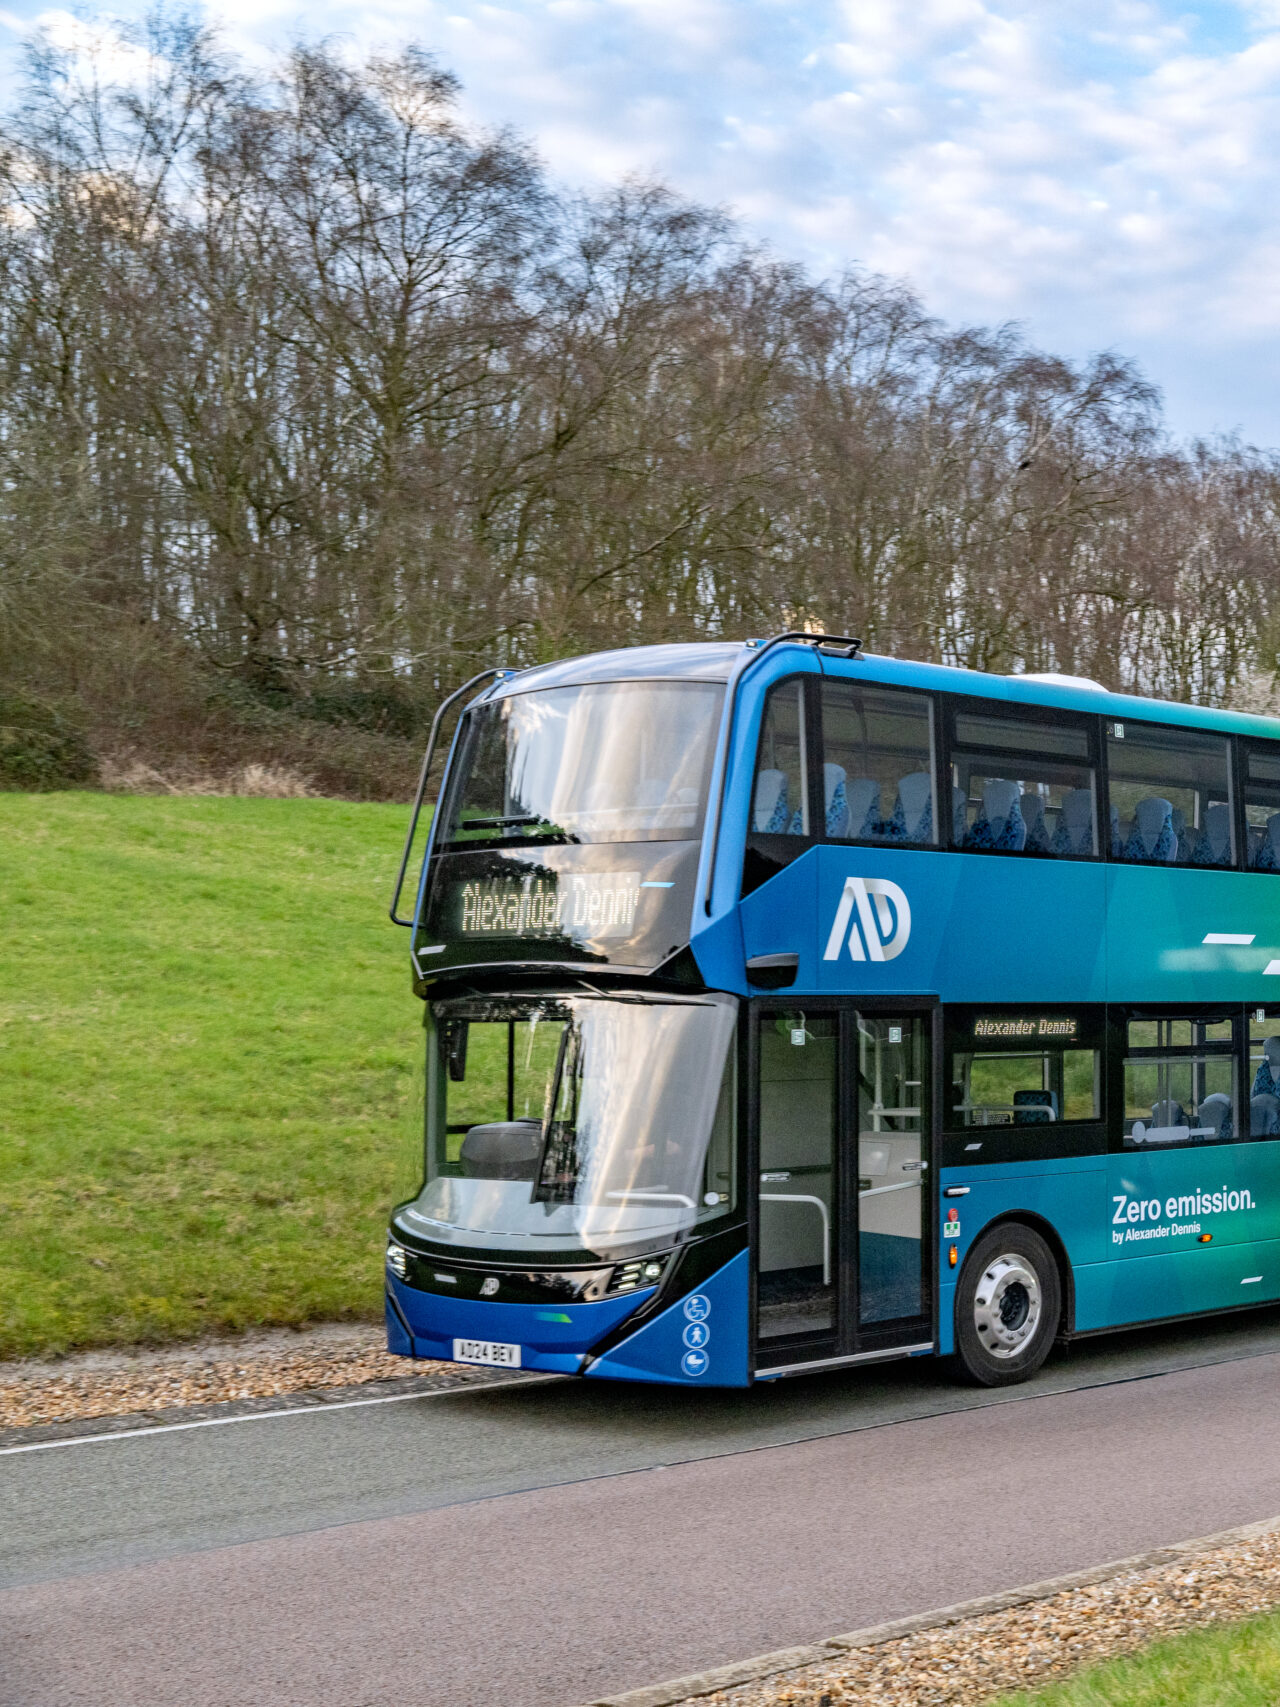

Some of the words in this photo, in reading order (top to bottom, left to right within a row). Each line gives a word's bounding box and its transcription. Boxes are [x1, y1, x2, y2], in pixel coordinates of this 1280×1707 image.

[462, 879, 568, 931] Alexander
[975, 1019, 1036, 1035] Alexander
[1038, 1019, 1077, 1034] Dennis
[1112, 1195, 1162, 1225] Zero
[1165, 1185, 1256, 1219] emission.
[1112, 1230, 1124, 1245] by
[1125, 1225, 1170, 1242] Alexander
[1171, 1221, 1201, 1236] Dennis
